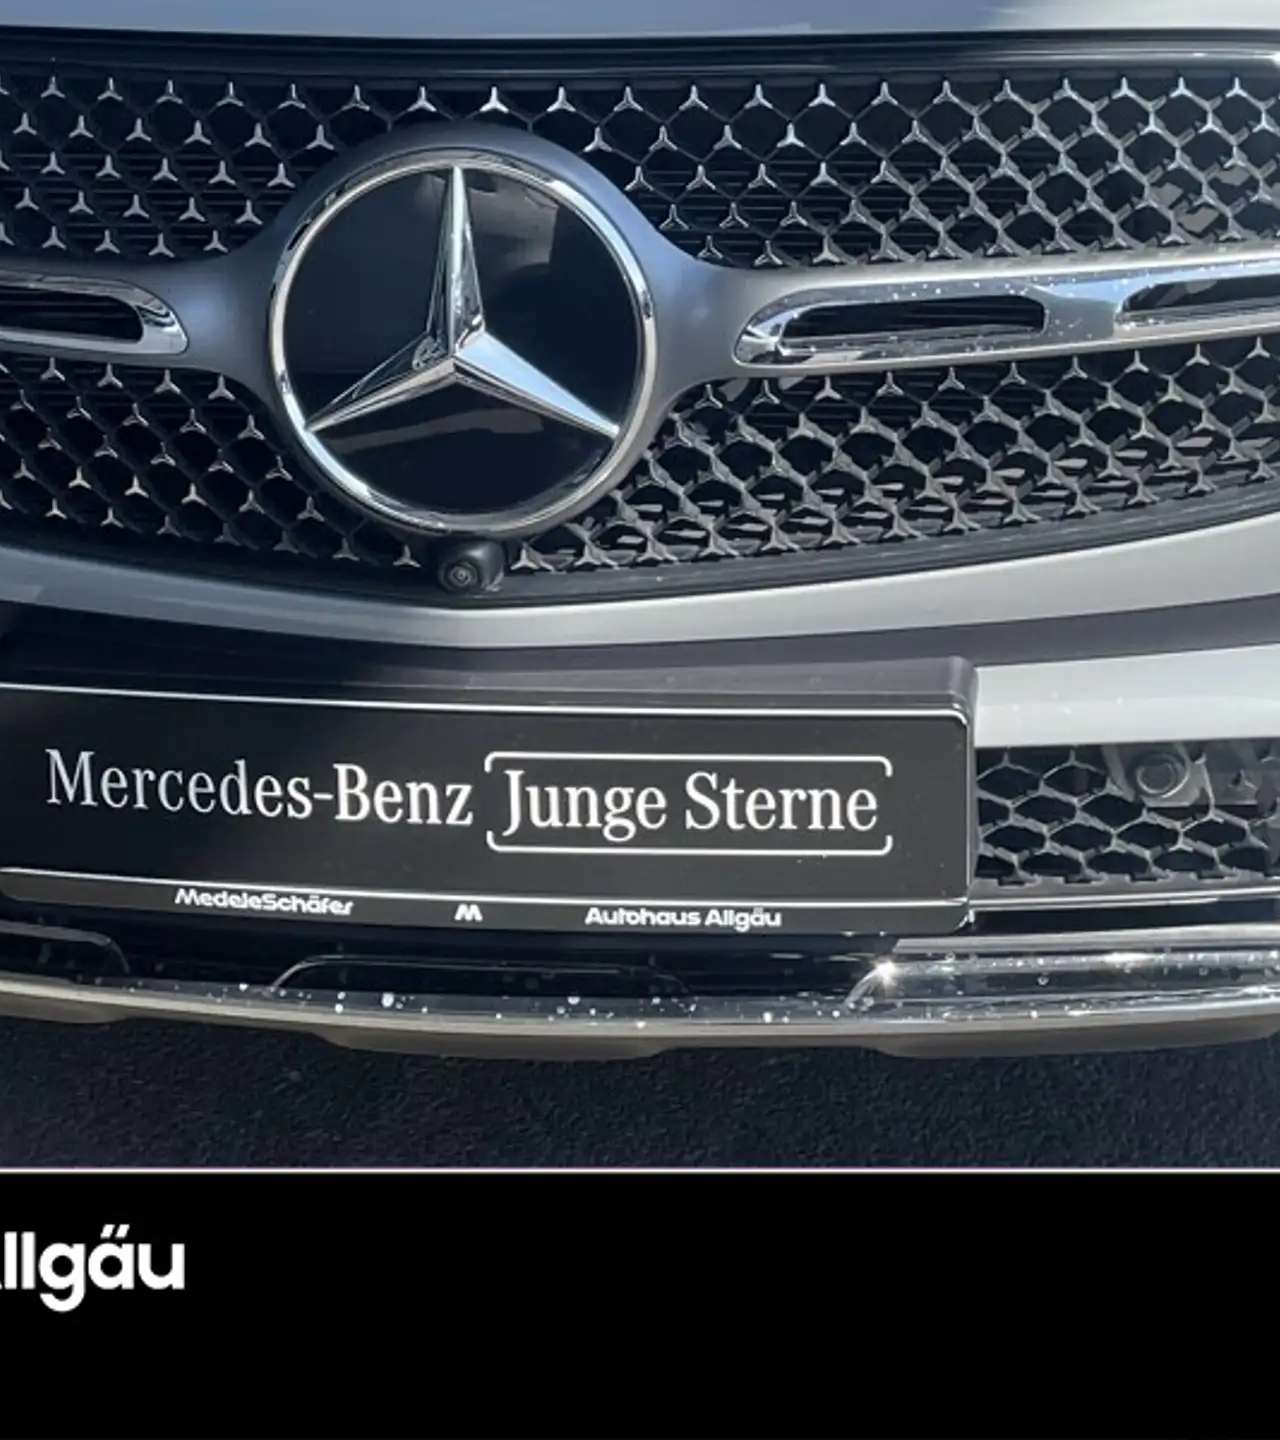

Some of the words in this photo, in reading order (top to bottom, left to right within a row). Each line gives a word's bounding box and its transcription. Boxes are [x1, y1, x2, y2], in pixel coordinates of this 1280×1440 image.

[45, 748, 474, 828] Mercedes-Benz
[500, 769, 668, 843] Junge
[685, 770, 878, 832] Sterne
[173, 887, 355, 916] MedeleSchäfer
[584, 906, 701, 926] Autohaus
[703, 905, 782, 933] Allgäu
